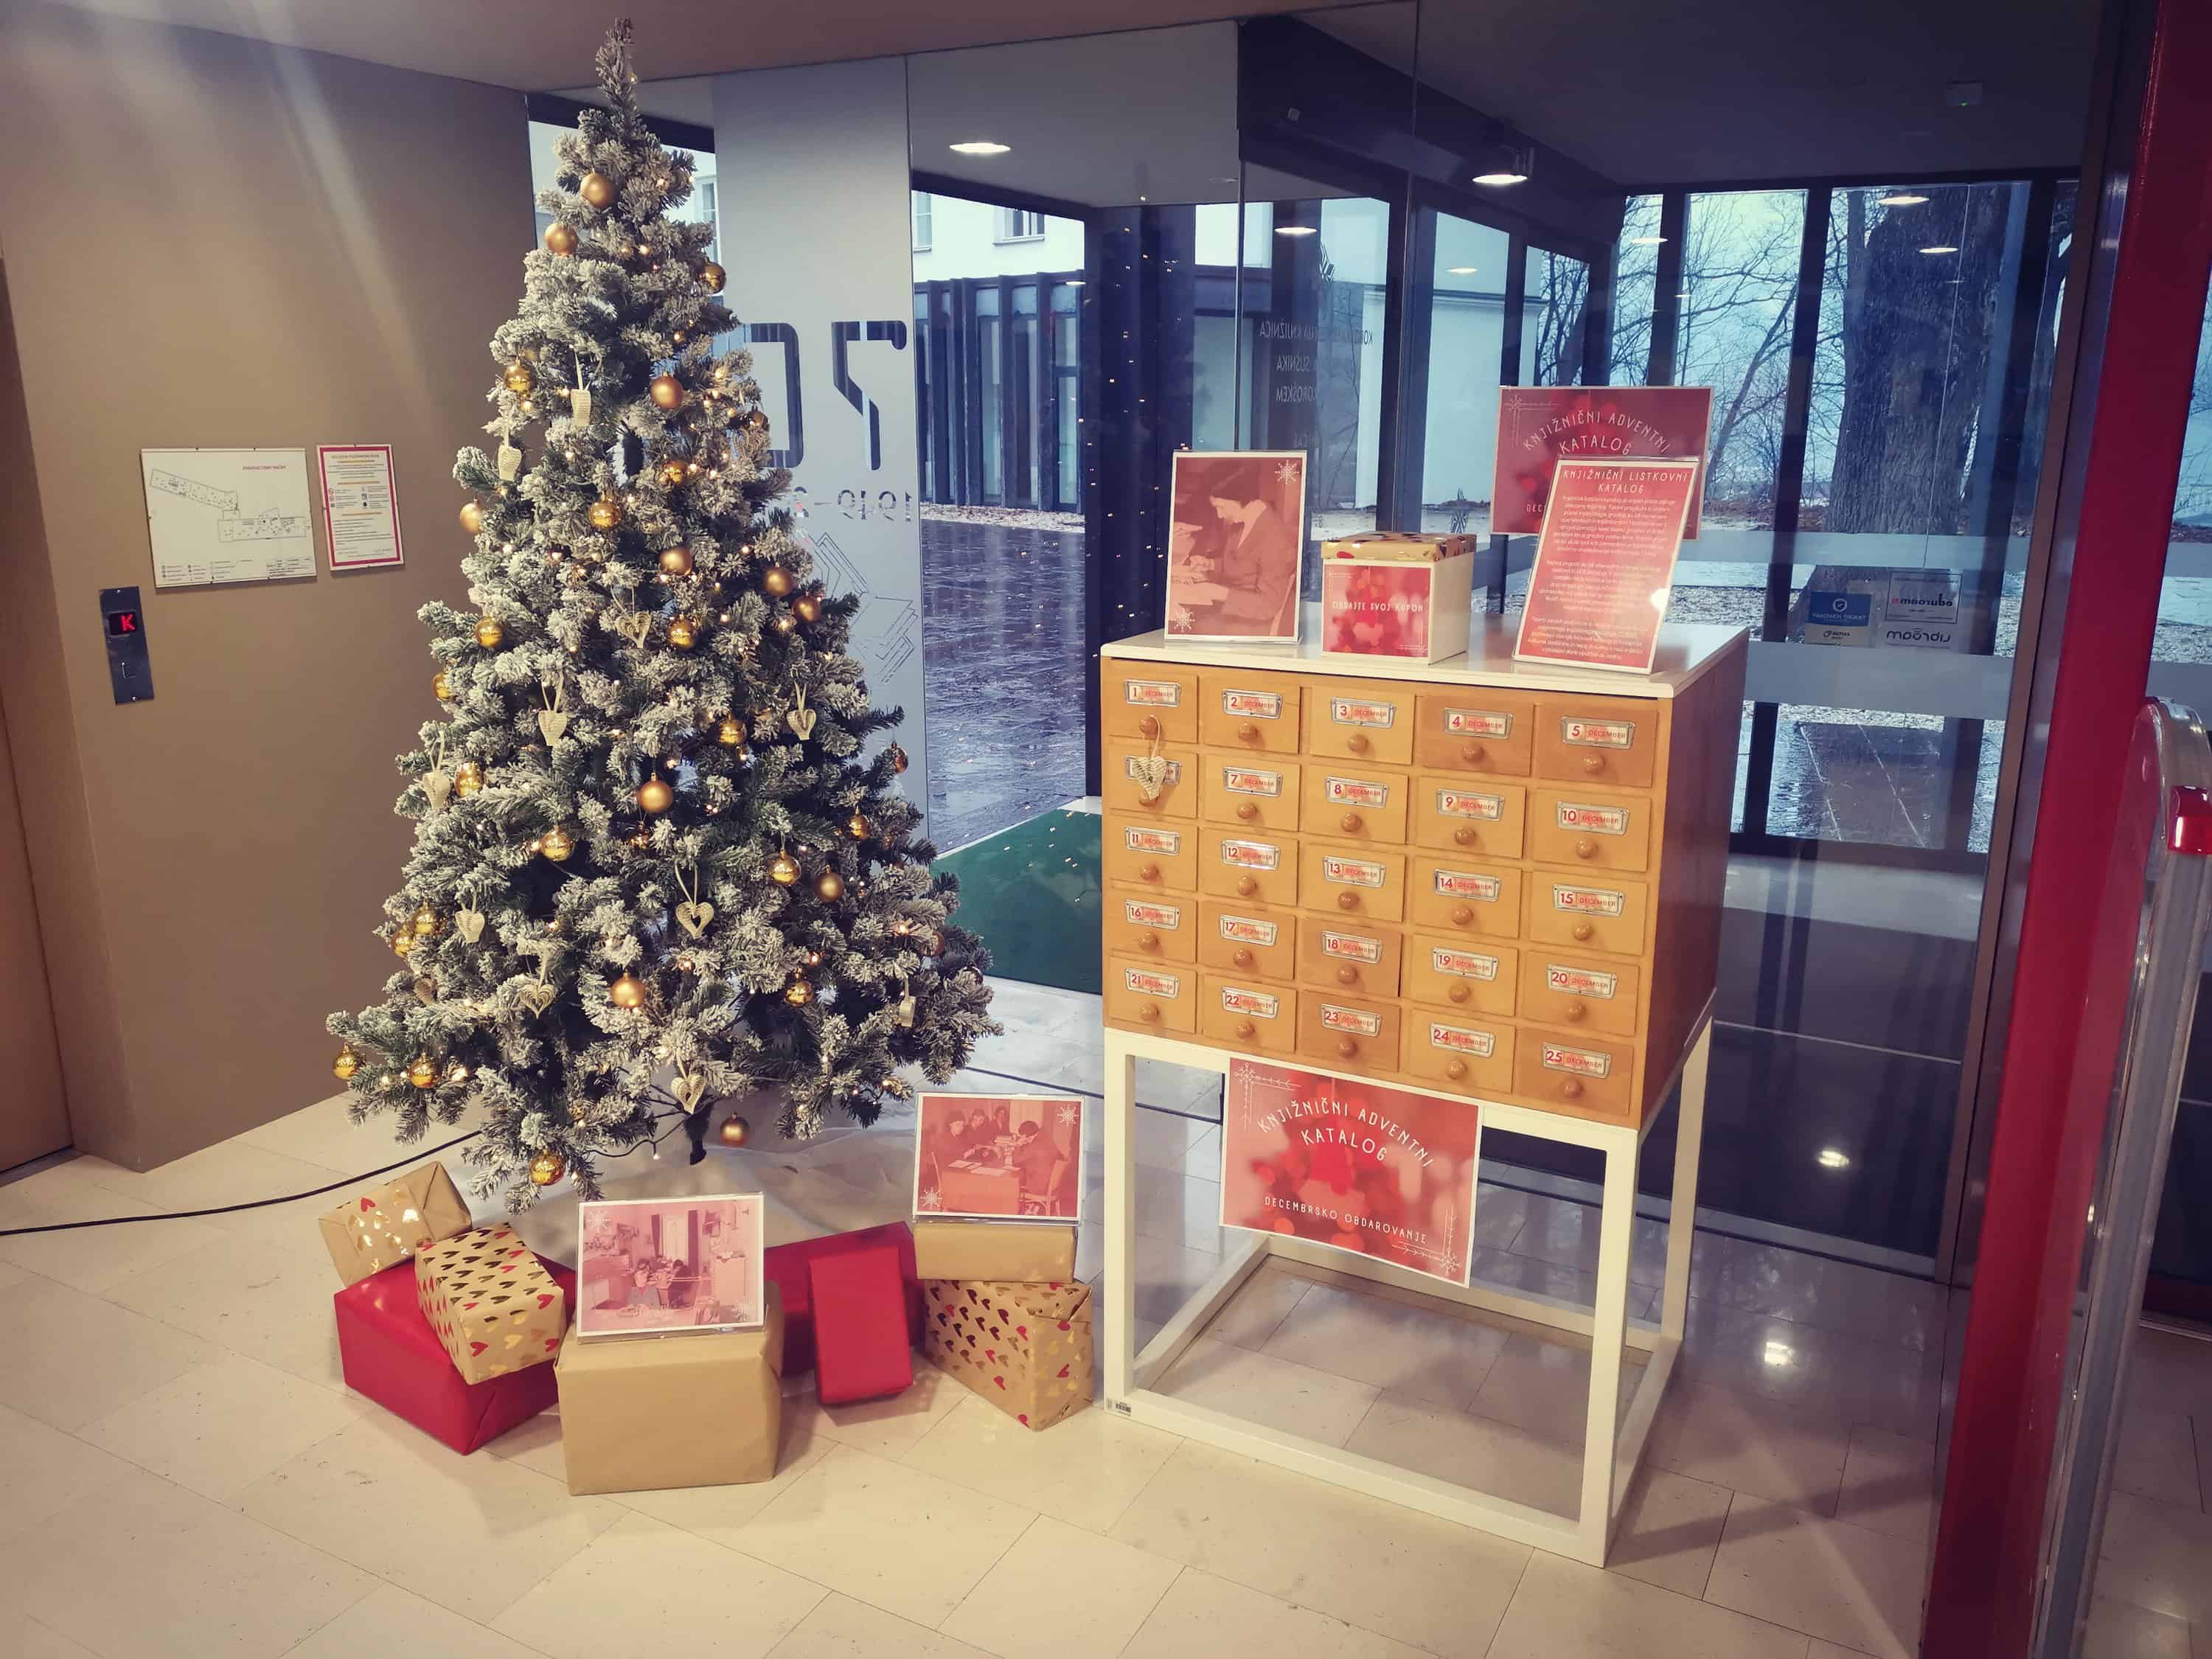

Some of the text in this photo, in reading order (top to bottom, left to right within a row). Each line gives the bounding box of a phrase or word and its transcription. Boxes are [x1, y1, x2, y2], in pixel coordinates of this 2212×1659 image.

[1523, 409, 1670, 454] KNJIŽNIČNI ADVENTNI
[1559, 436, 1632, 455] KATALOG
[1562, 467, 1688, 482] KNJIŽNIČNI LISTKOVNI
[1597, 483, 1645, 494] KATALOG
[1370, 602, 1391, 611] SVOJ
[1396, 603, 1424, 612] KUPON
[119, 613, 135, 630] K
[1132, 687, 1173, 698] 1 DECEMBER
[1231, 696, 1275, 709] 2 DECEMBER
[1339, 706, 1387, 717] 3 DECEMBER
[1452, 716, 1503, 729] 4 DECEMBER
[1572, 726, 1627, 739] 5 DECEMBER
[1231, 774, 1275, 787] 7 DECEMBER
[1334, 784, 1381, 797] 8 DECEMBER
[1446, 797, 1495, 811] 9 DECEMBER
[1562, 810, 1618, 825] 10 DECEMBER
[1132, 833, 1173, 847] 11 DECEMBER
[1227, 848, 1273, 861] 12 DECEMBER
[1330, 863, 1377, 878] 13 DECEMBER
[1439, 877, 1492, 891] 14 DECEMBER
[1560, 893, 1616, 907] 15 DECEMBER
[1131, 907, 1173, 921] 16 DECEMBER
[1225, 922, 1270, 936] 17 DECEMBER
[1327, 939, 1375, 953] 18 DECEMBER
[1439, 955, 1489, 972] 19 DECEMBER
[1132, 974, 1173, 990] 21 DECEMBER
[1551, 972, 1608, 990] 20 DECEMBER
[1227, 995, 1273, 1009] 22 DECEMBER
[1324, 1011, 1374, 1027] 23 DECEMBER
[1433, 1029, 1487, 1047] 24 DECEMBER
[1545, 1051, 1603, 1068] 25 DECEMBER
[1257, 1096, 1434, 1168] KNJIŽNIČNI ADVENTNI
[1301, 1127, 1387, 1162] KATALOG
[1265, 1196, 1427, 1244] DECEMBRSKO OBDAROVANJE
